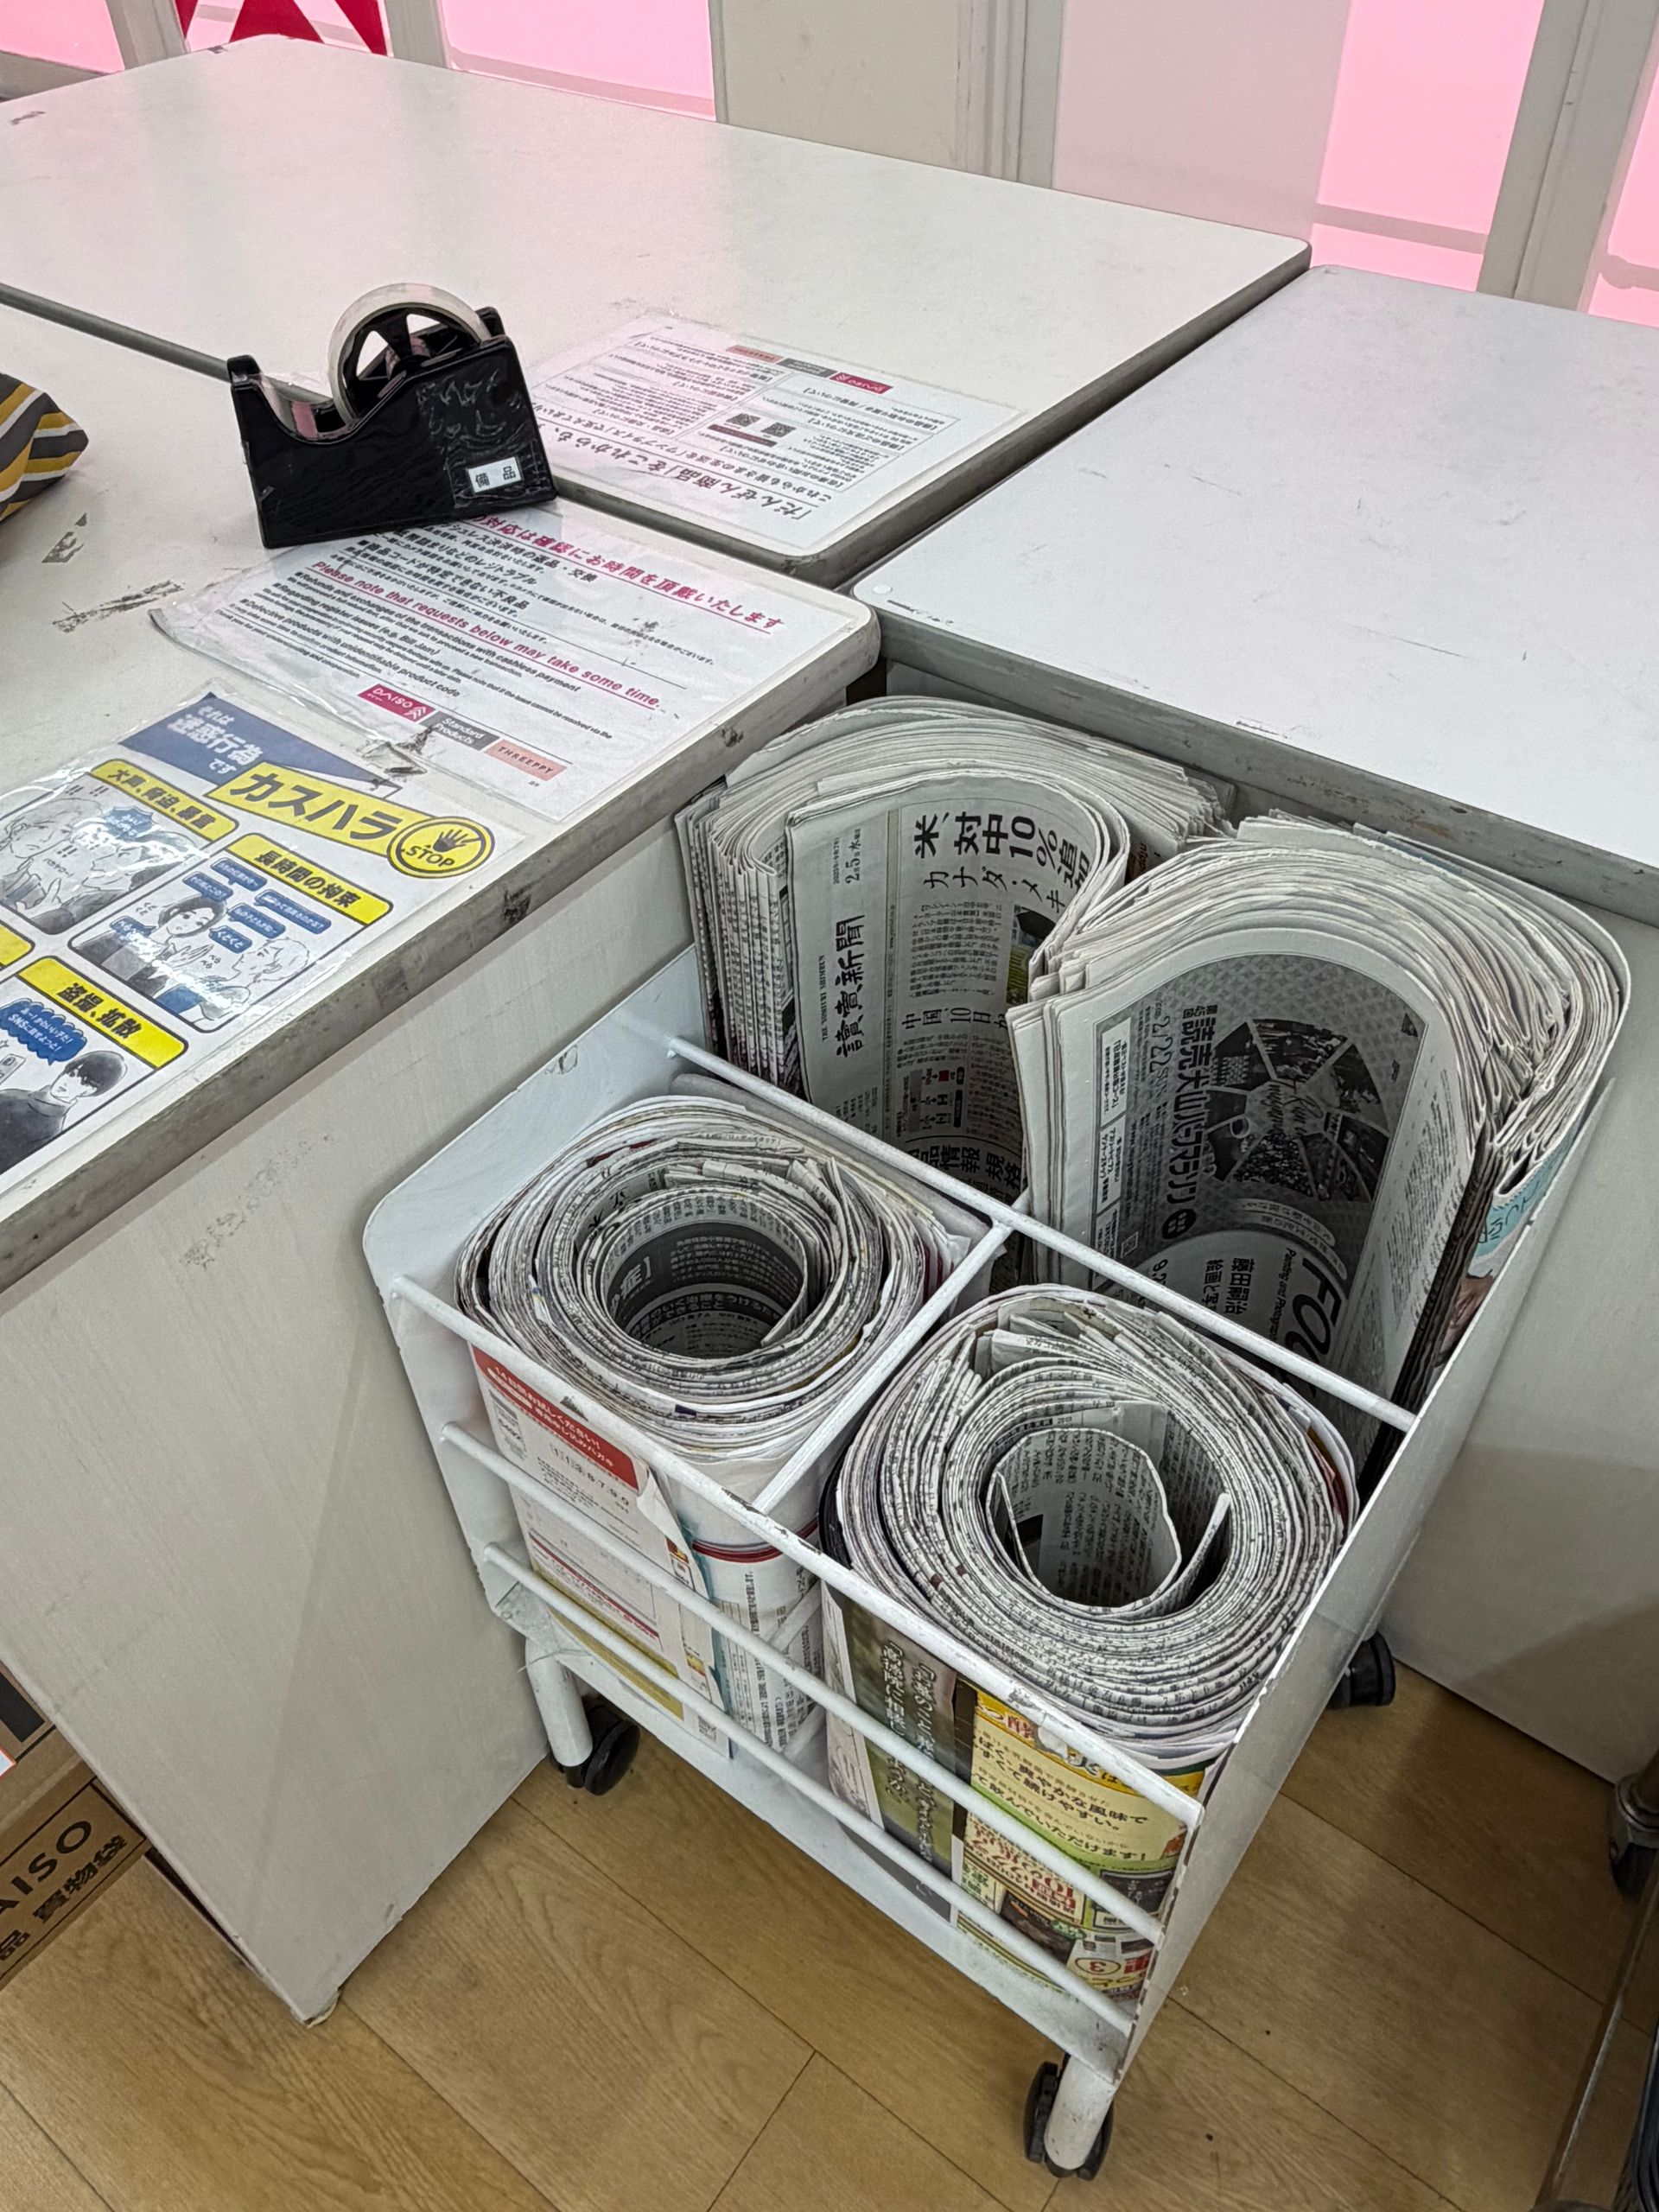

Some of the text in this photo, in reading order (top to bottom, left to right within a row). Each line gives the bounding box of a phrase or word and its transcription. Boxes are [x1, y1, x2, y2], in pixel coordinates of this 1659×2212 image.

[475, 465, 517, 487] 備品
[537, 422, 813, 520] 「だんぜん商品」をこれからも、
[276, 584, 323, 606] Regarding
[316, 601, 354, 619] register
[350, 614, 382, 630] issues
[397, 634, 418, 645] Bill
[297, 573, 338, 591] Refunds
[332, 588, 353, 597] and
[346, 594, 397, 617] exchanges
[403, 616, 423, 626] the
[418, 621, 479, 649] transactions
[474, 645, 500, 658] with
[494, 652, 541, 675] cashless
[534, 671, 582, 693] payment
[310, 561, 666, 708] Please note that requests below may take some time.
[243, 601, 463, 697] Defective products with unidentifiable product code
[195, 704, 236, 726] それは
[370, 687, 415, 709] DAISO
[164, 712, 268, 766] 迷惑行為
[429, 722, 477, 746] Products
[439, 717, 485, 740] Standard
[204, 757, 238, 776] です
[495, 746, 556, 775] THREEPPY
[105, 766, 219, 830] 大声、脅迫、暴言
[226, 770, 406, 846] カスハラ
[252, 849, 363, 908] 長時間の拘束
[404, 843, 456, 869] STOP
[923, 866, 1065, 913] カナダ・メキ
[54, 981, 145, 1040] 盗撮、拡散
[834, 912, 866, 1058] 讀賣新聞
[1166, 1017, 1217, 1205] 読売犬山ハーフマラソン
[1225, 1257, 1255, 1315] 藤田嗣治
[1277, 1281, 1288, 1298] and
[1279, 1248, 1297, 1281] Painting
